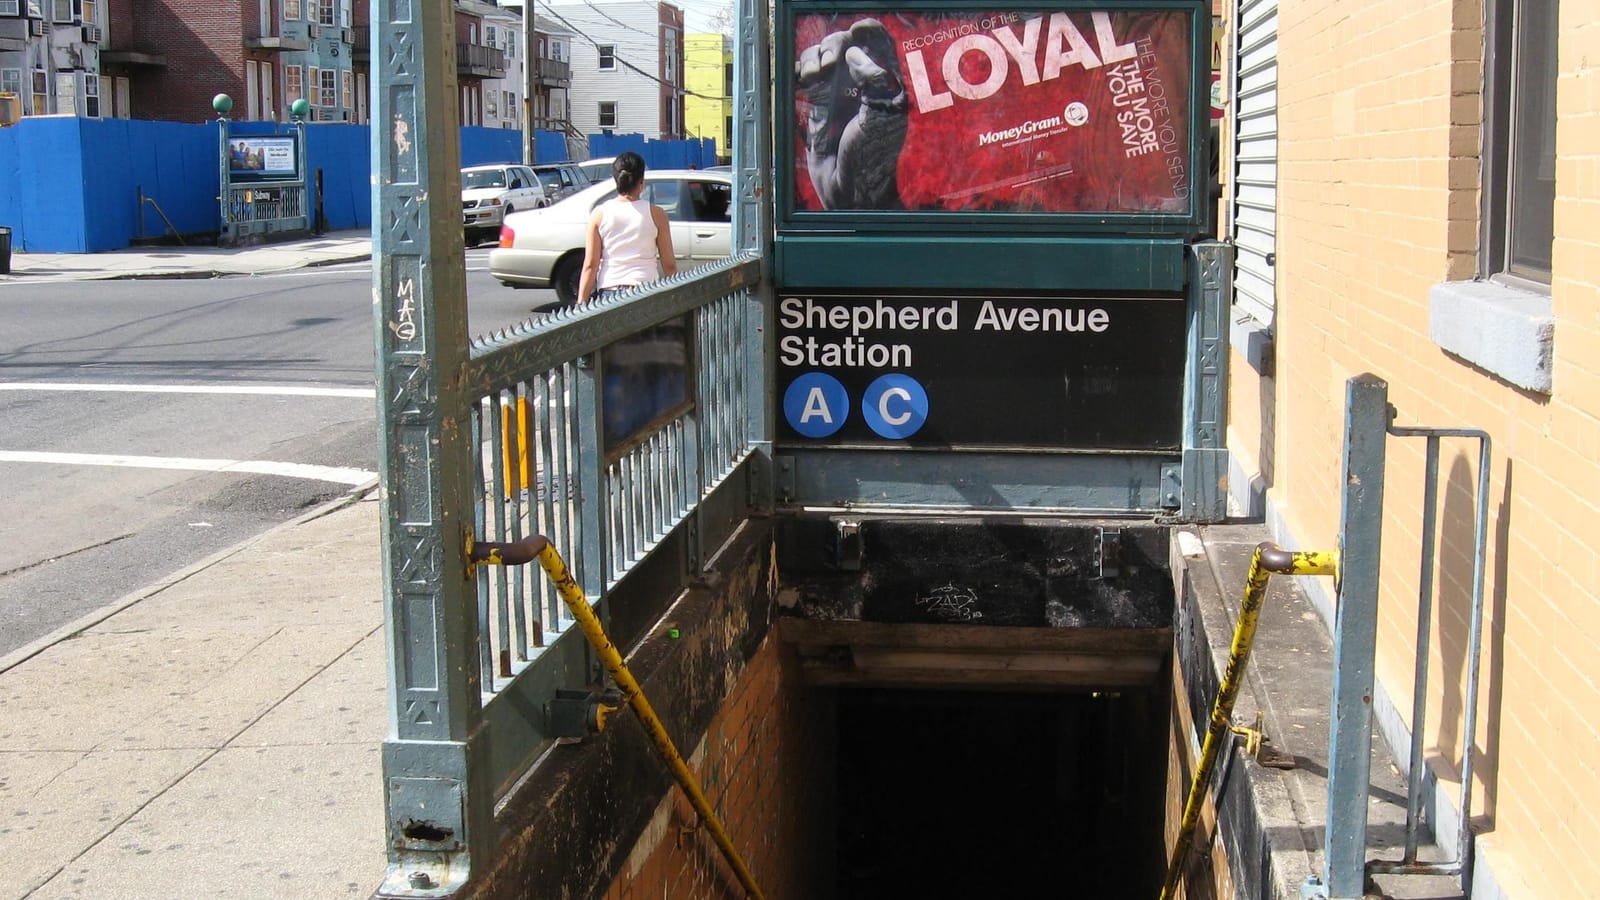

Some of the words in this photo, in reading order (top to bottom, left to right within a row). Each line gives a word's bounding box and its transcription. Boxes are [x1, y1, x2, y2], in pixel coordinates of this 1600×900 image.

[902, 24, 979, 51] RECOGNITION
[981, 16, 997, 30] OF
[998, 11, 1018, 25] THE
[1136, 35, 1157, 64] THE
[905, 11, 1138, 114] LOYAL
[1122, 60, 1145, 94] THE
[1106, 64, 1130, 107] YOU
[1144, 66, 1169, 118] MORE
[979, 116, 1061, 146] MoneyGram
[1117, 111, 1142, 158] SAVE
[1131, 97, 1159, 154] MORE
[1158, 119, 1178, 154] YOU
[1166, 155, 1189, 200] SEND
[779, 297, 959, 335] Shepherd
[974, 300, 1111, 333] Avenue
[779, 335, 913, 368] Station
[800, 387, 833, 424] A
[878, 387, 913, 426] C
